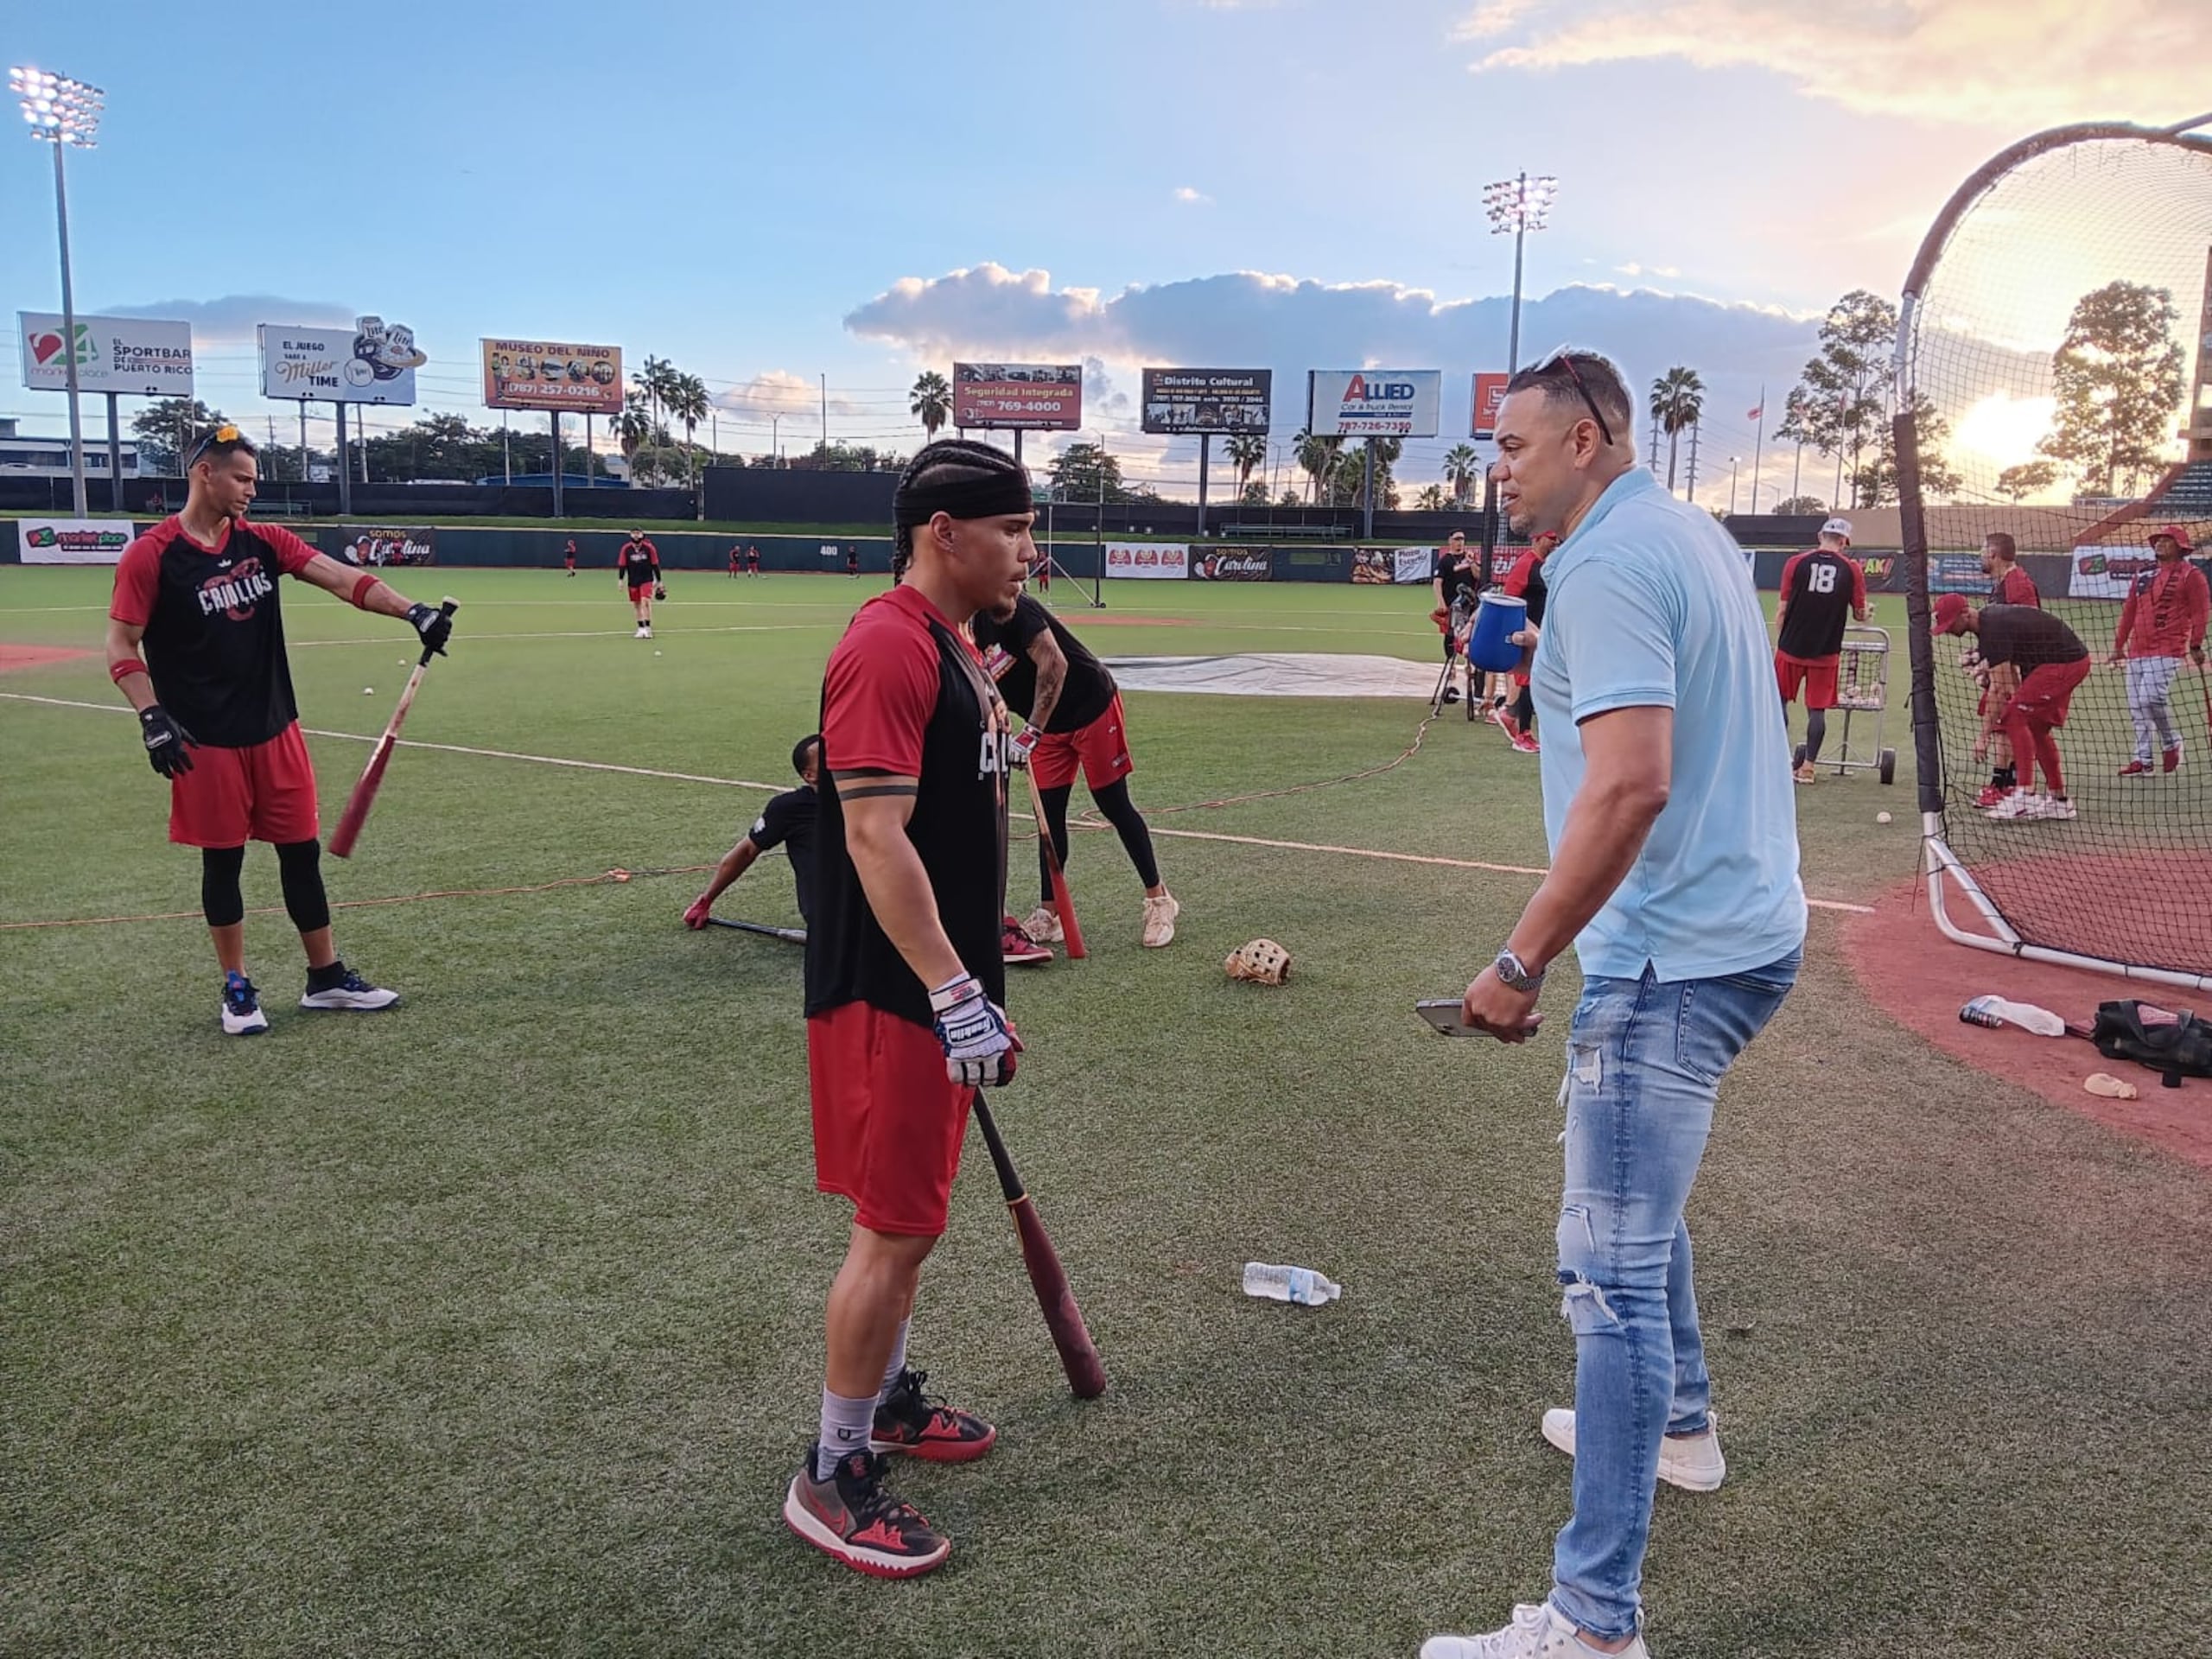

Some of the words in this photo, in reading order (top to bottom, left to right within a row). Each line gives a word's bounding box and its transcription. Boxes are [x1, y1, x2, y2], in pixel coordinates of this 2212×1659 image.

[283, 340, 292, 350] EL
[296, 342, 325, 352] JUEGO
[496, 342, 543, 354] MUSEO
[548, 346, 571, 356] DEL
[113, 346, 191, 359] SPORTBAR
[114, 363, 161, 374] PUERTO
[164, 366, 192, 375] RICO
[275, 360, 339, 384] Miller
[308, 375, 338, 387] TIME
[1164, 375, 1207, 386] Distrito
[1210, 377, 1254, 387] Cultural
[963, 386, 1019, 397] Seguridad
[1021, 388, 1073, 398] Integrada
[1343, 374, 1415, 403] ALLIED
[997, 401, 1061, 412] 769-4000
[820, 545, 838, 556] 400
[1808, 563, 1837, 594] 18
[198, 571, 272, 615] CRIOLLOS
